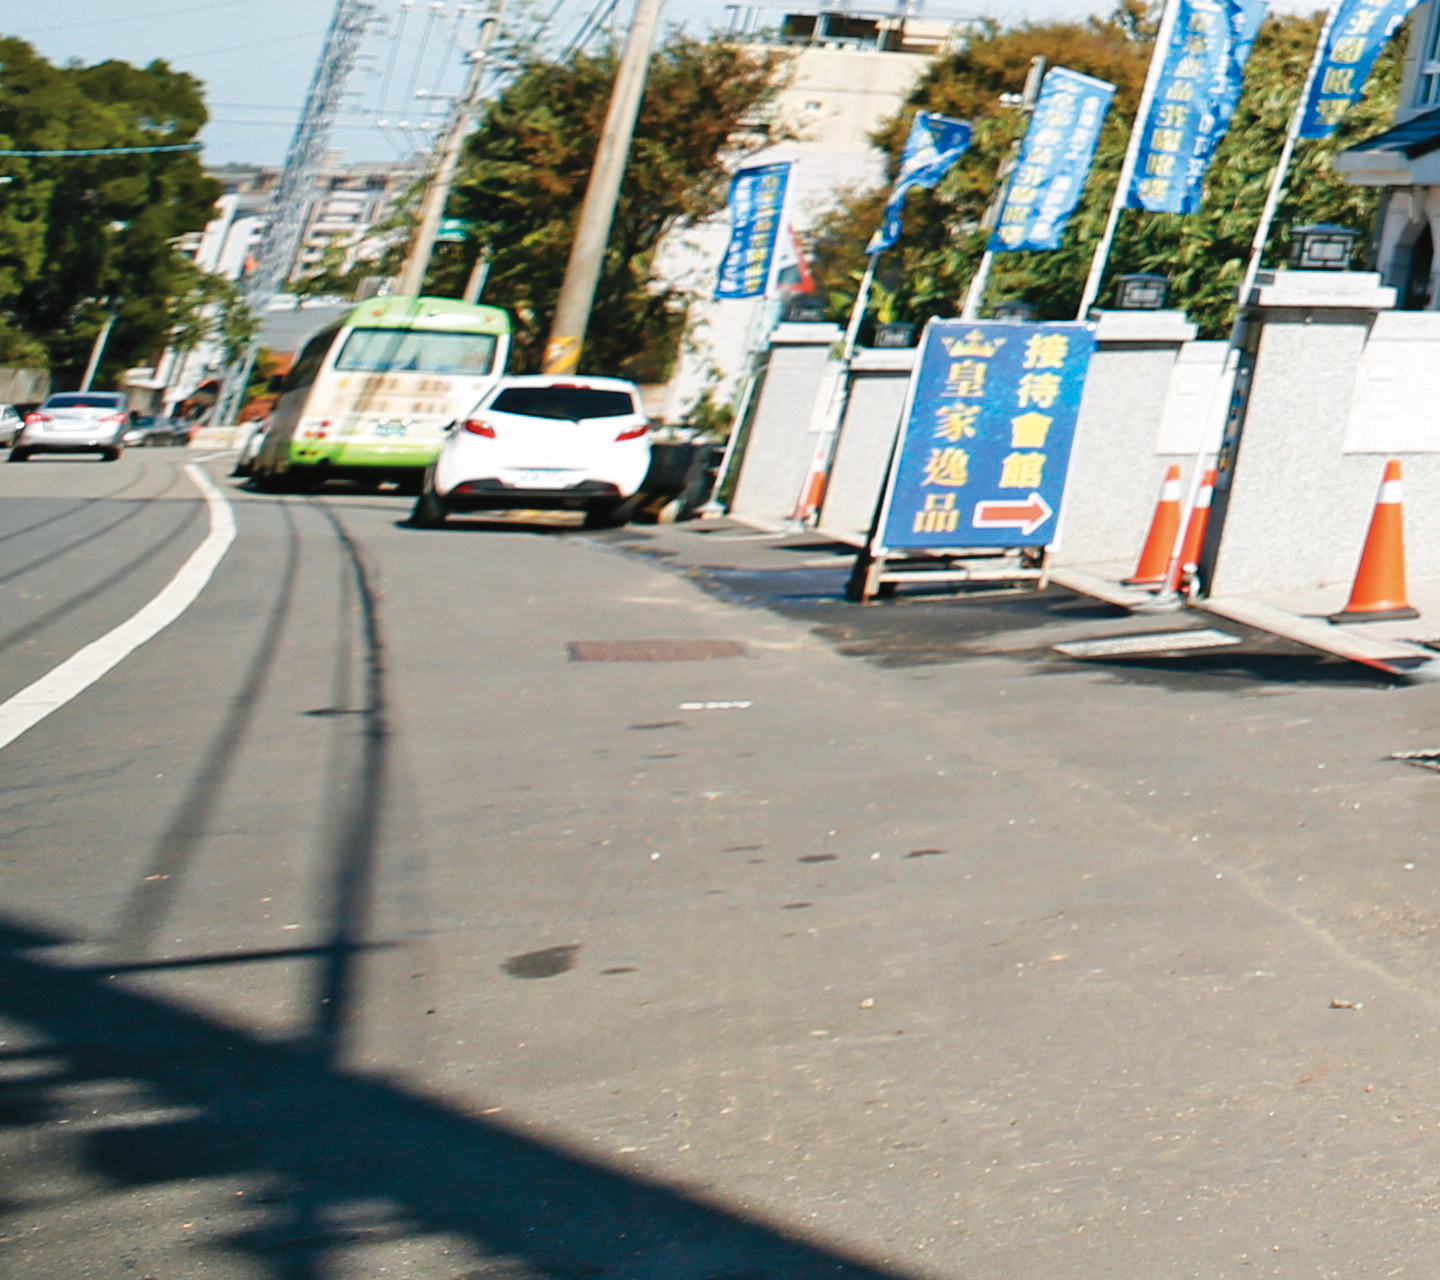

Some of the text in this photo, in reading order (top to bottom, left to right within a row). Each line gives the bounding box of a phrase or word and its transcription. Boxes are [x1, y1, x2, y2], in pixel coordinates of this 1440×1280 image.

[912, 358, 988, 533] 皇家逸品
[998, 332, 1070, 490] 接待會館
